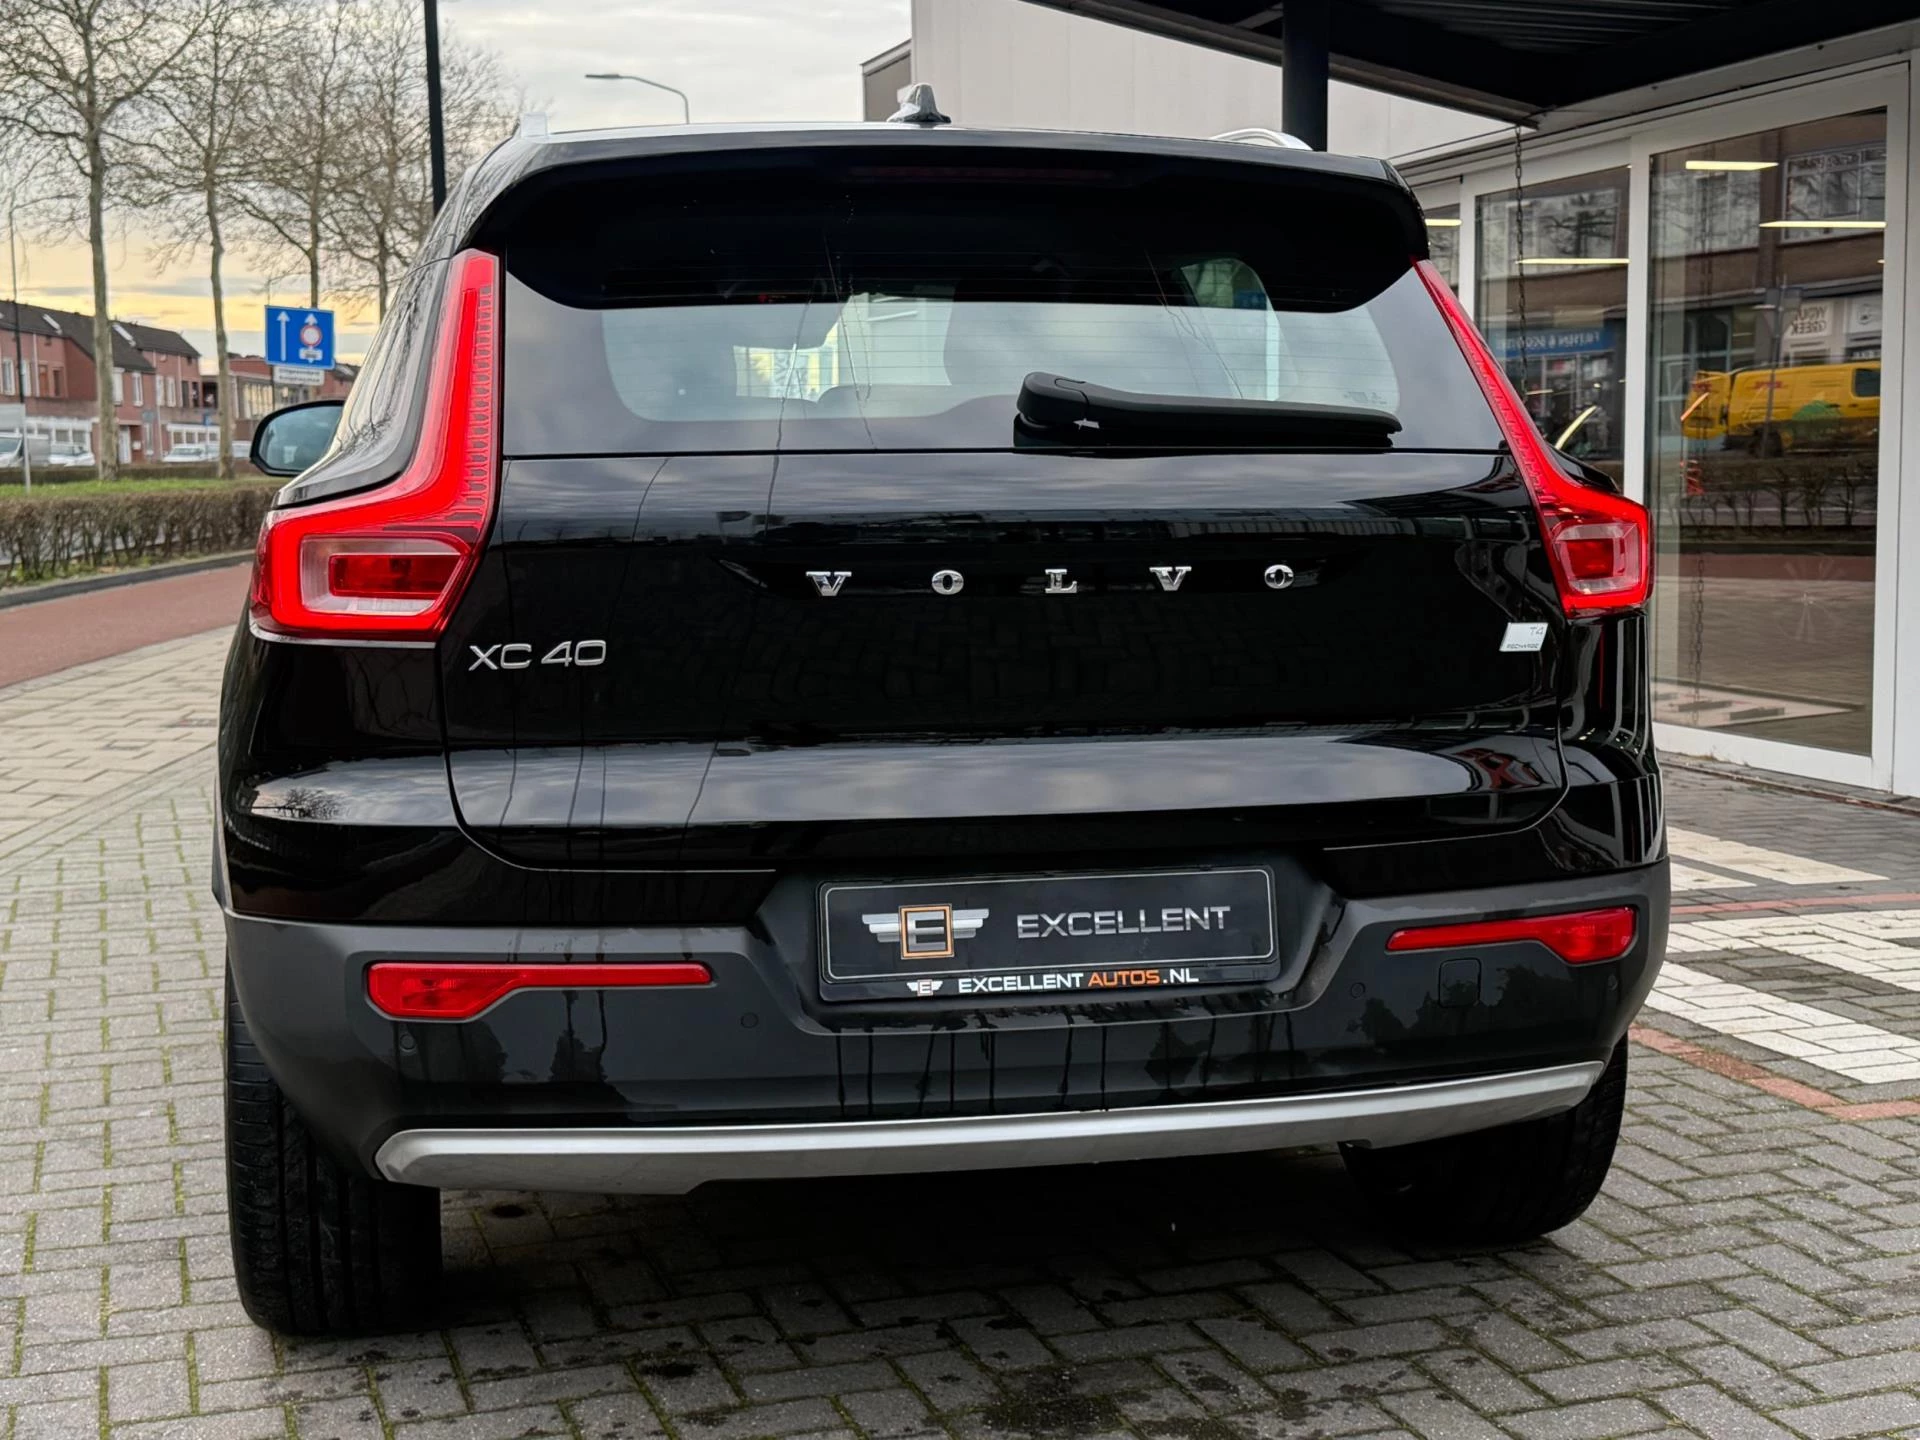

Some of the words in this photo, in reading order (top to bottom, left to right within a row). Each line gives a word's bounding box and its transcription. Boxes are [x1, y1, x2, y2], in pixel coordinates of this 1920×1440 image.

[805, 564, 1295, 597] VOLVO
[1017, 906, 1231, 938] EXCELLENT
[958, 973, 1084, 993] EXCELLENT
